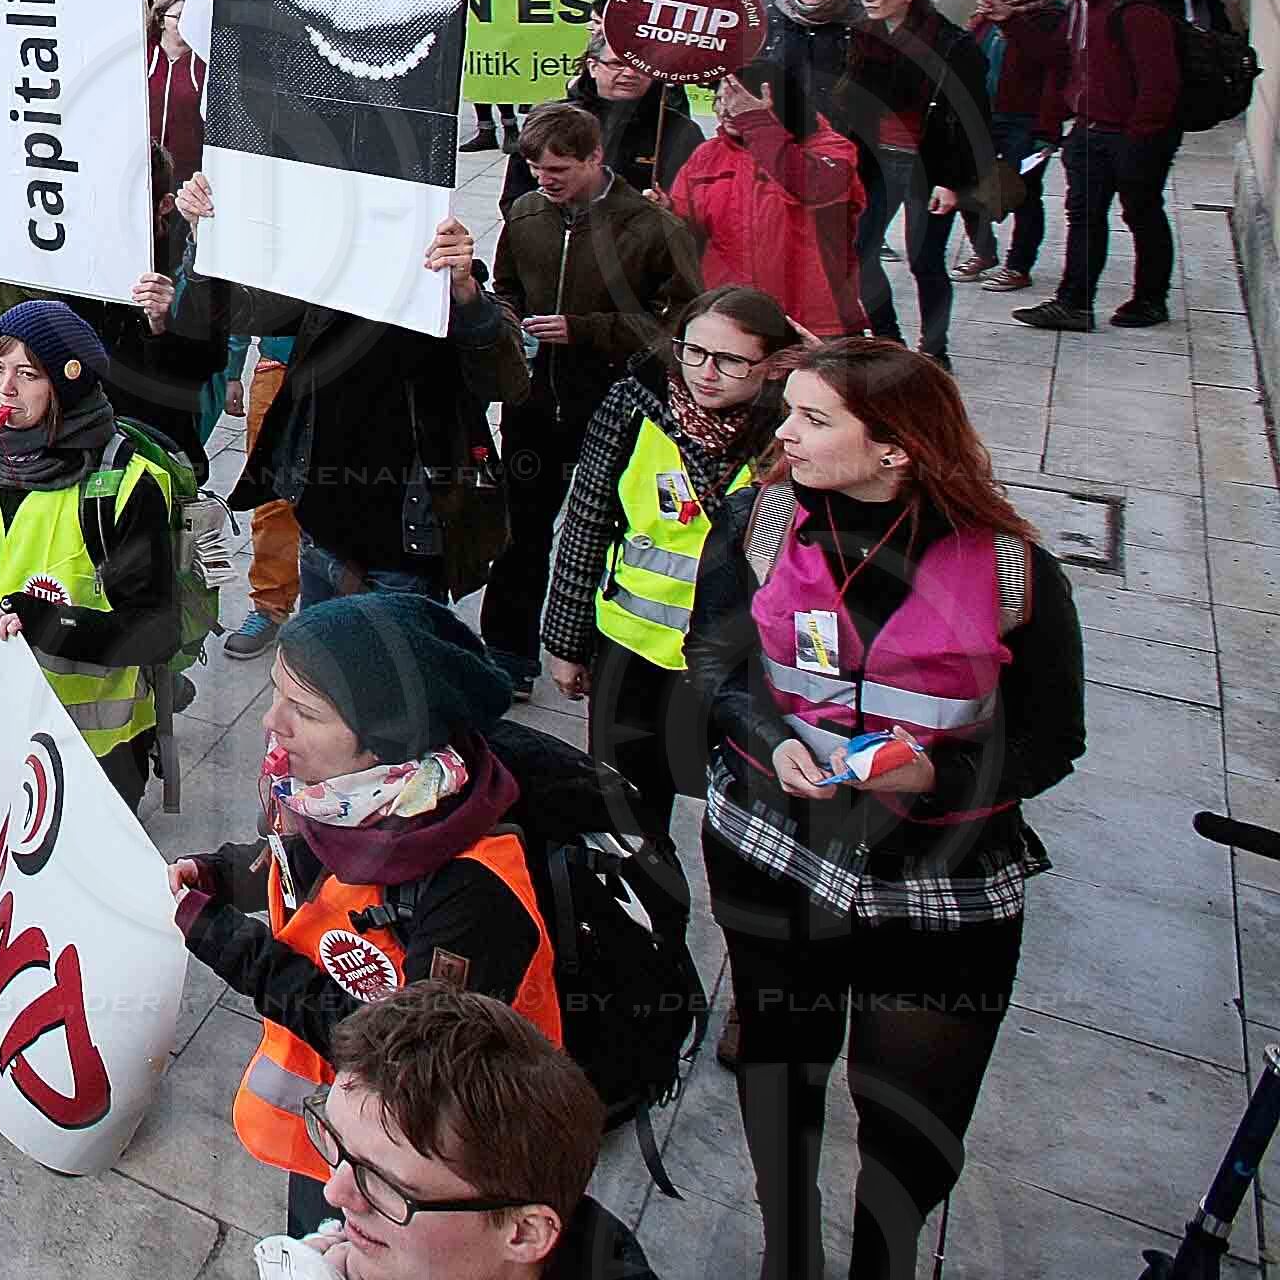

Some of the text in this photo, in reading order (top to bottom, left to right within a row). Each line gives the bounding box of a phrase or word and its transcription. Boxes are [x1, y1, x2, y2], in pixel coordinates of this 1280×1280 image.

[635, 24, 727, 52] STOPPEN
[465, 51, 520, 76] litik
[623, 50, 651, 73] sieht
[704, 64, 727, 78] aus
[32, 585, 61, 603] TTIP
[332, 948, 366, 971] TTIP
[344, 962, 380, 982] STOPPEN
